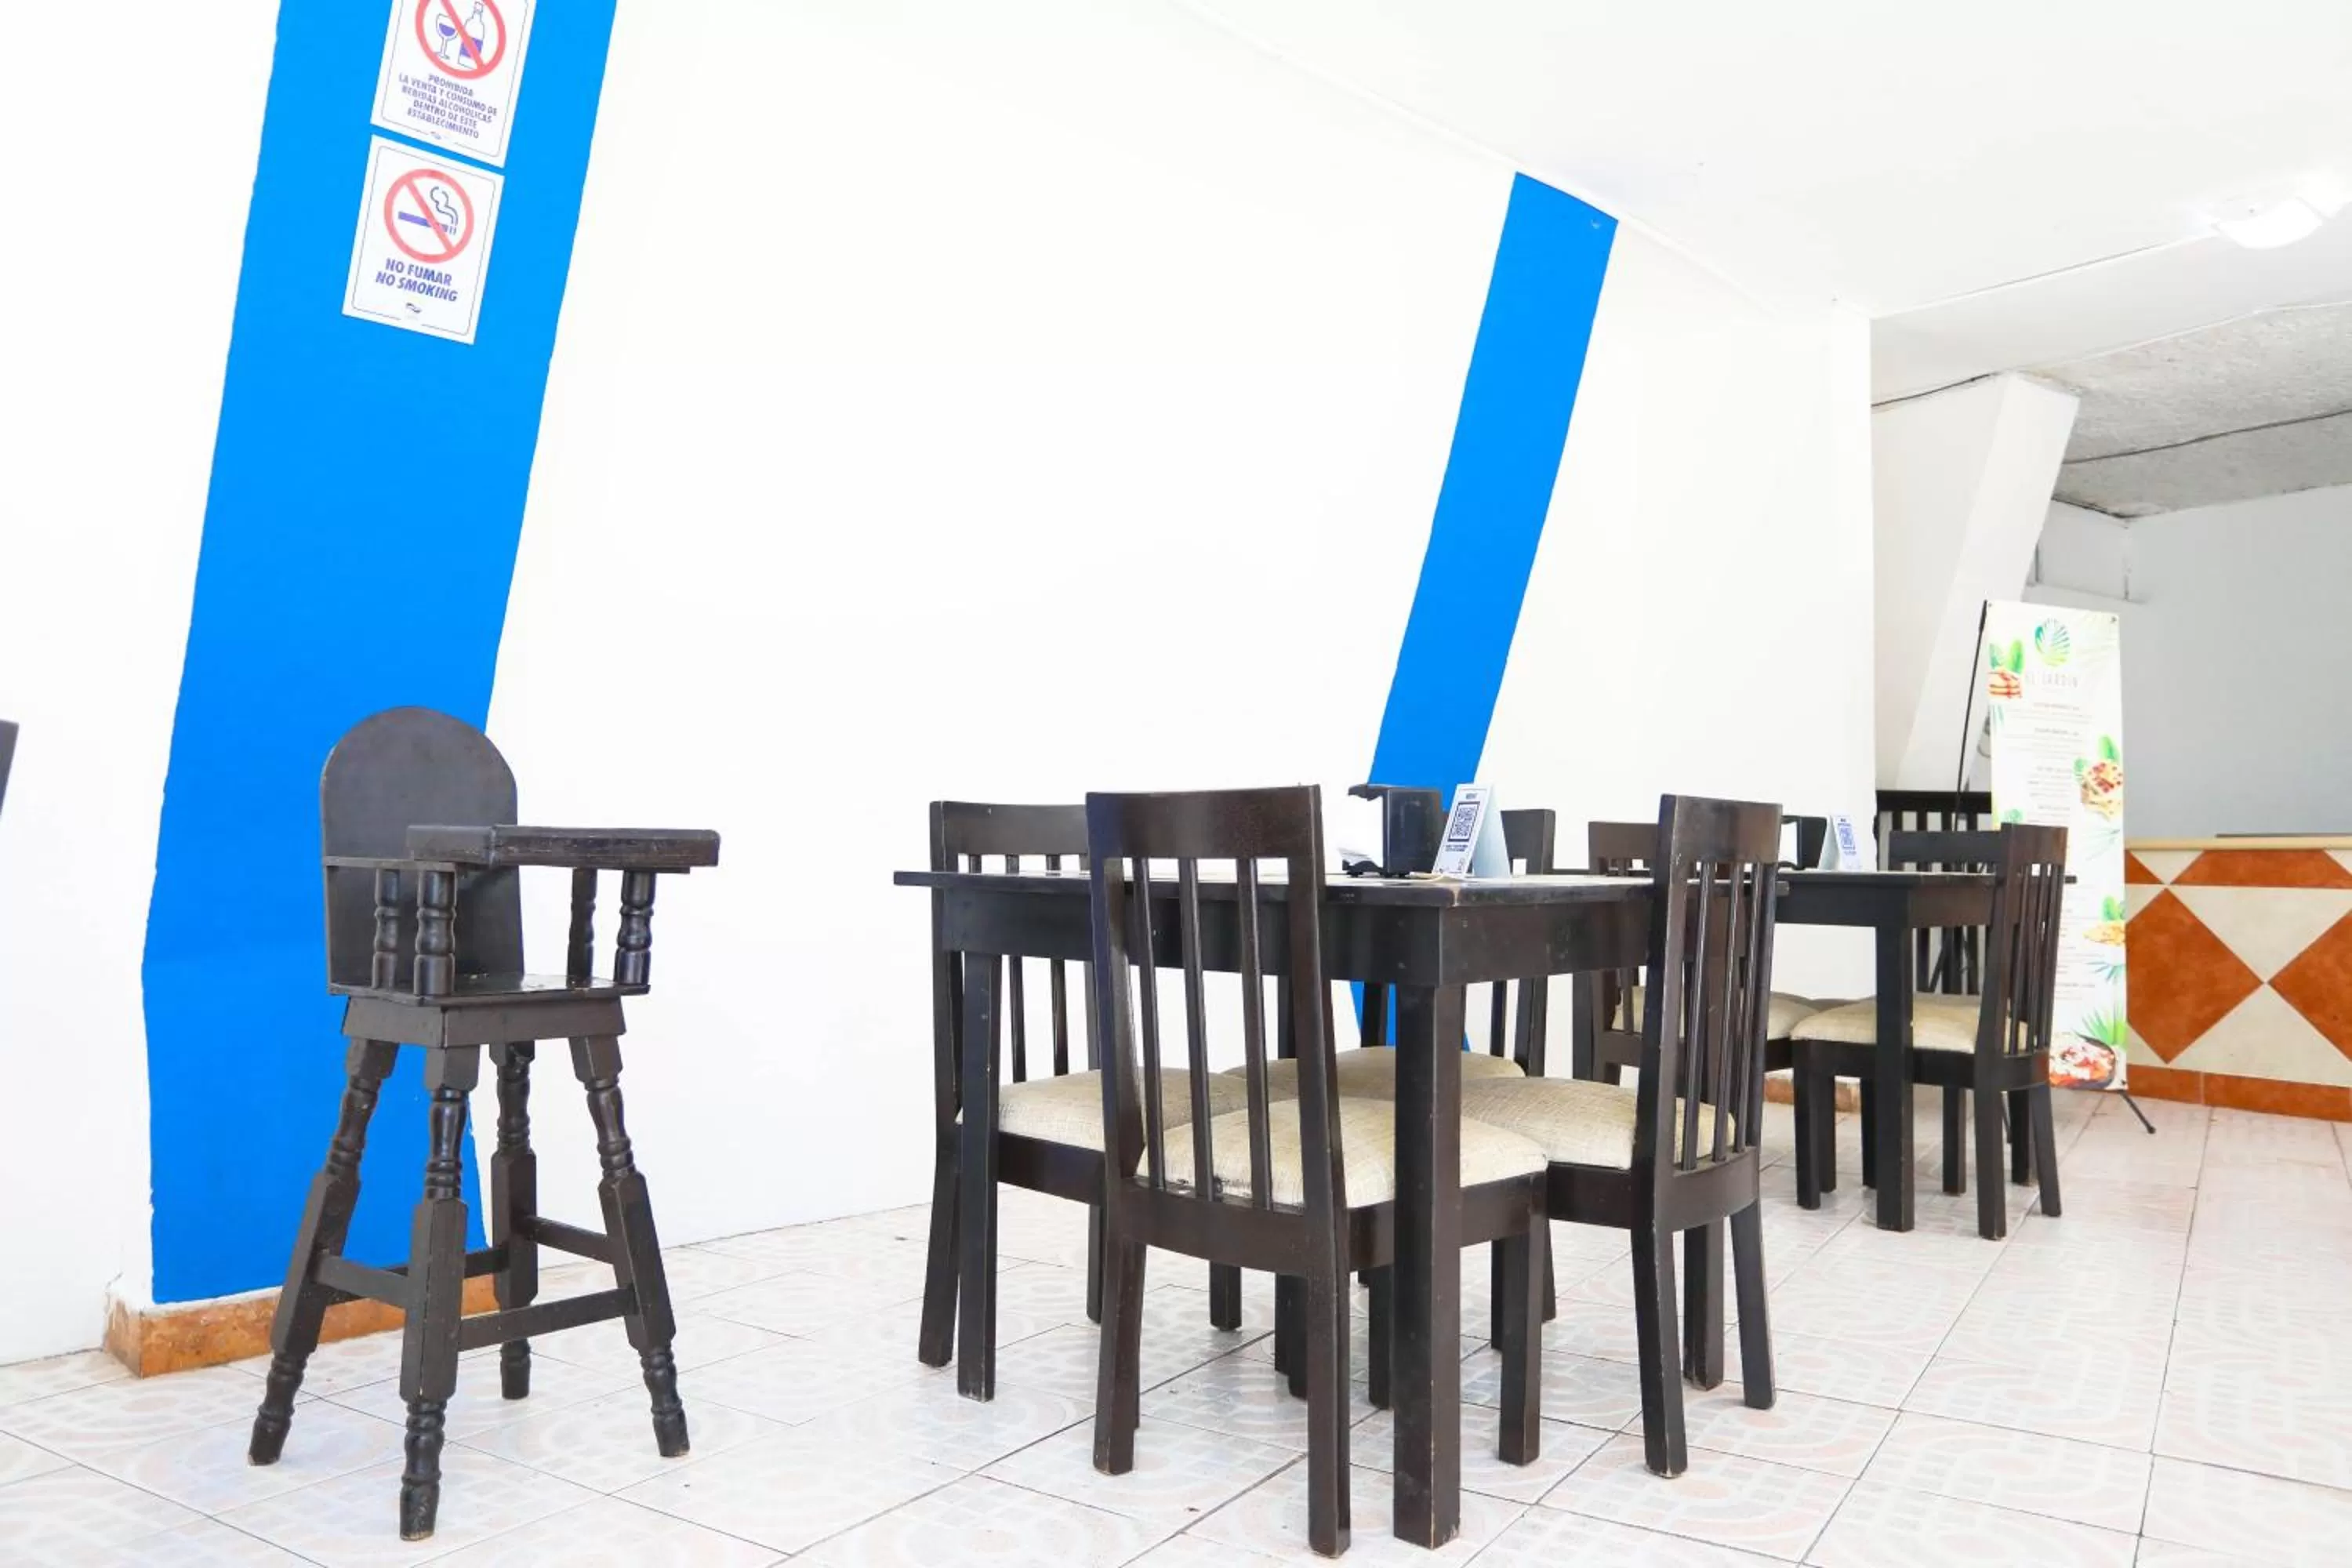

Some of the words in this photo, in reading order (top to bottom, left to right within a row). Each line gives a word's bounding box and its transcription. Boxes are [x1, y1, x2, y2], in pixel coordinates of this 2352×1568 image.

[399, 73, 408, 84] LA
[411, 78, 437, 94] VENTA
[438, 87, 445, 96] Y
[446, 90, 486, 111] CONSUMO
[487, 106, 497, 116] DE
[401, 85, 437, 103] BEBIDAS
[428, 74, 474, 96] PROHIBIDA
[407, 107, 479, 139] ESTABLECIMIENTO
[413, 100, 446, 117] DENTRO
[448, 112, 458, 122] DE
[460, 115, 477, 129] ESTE
[375, 271, 396, 286] NO
[397, 277, 458, 301] SMOKING
[386, 258, 405, 274] NO
[407, 263, 452, 286] FUMAR
